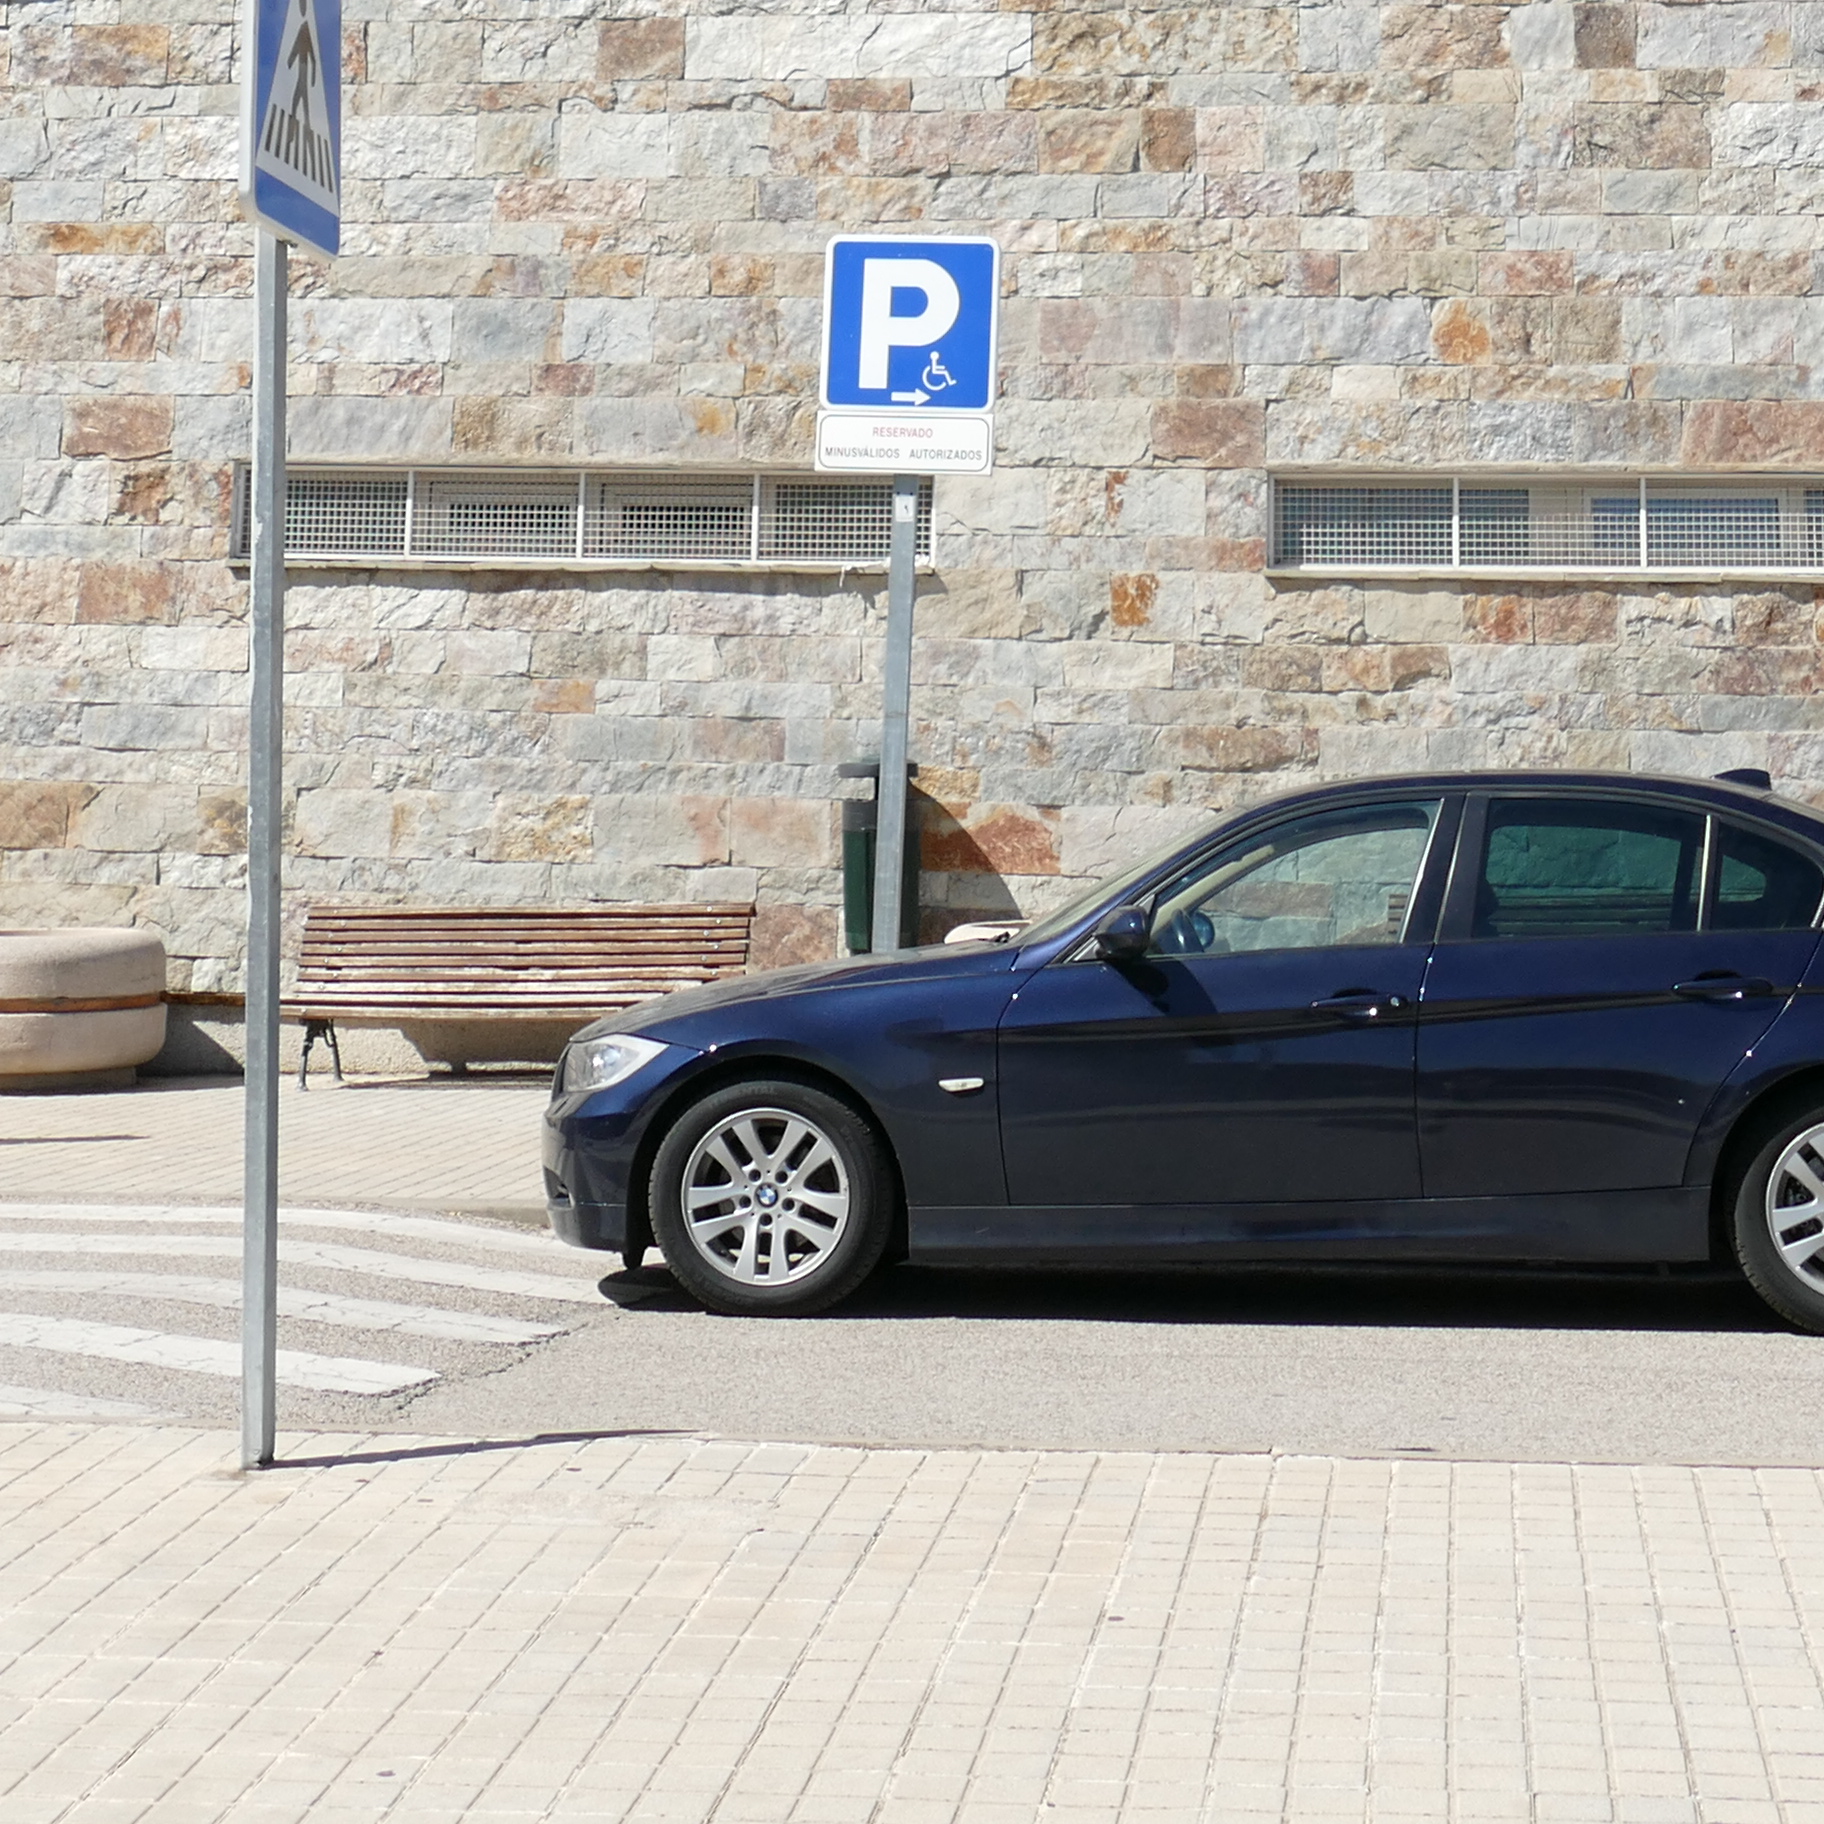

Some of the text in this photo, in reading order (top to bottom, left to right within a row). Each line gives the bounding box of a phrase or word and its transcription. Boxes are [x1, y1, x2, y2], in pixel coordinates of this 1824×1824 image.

[858, 258, 961, 389] P
[872, 426, 934, 439] RESERVADO
[825, 445, 983, 461] MINUSVÁLIDOS AUTORIZADOS
